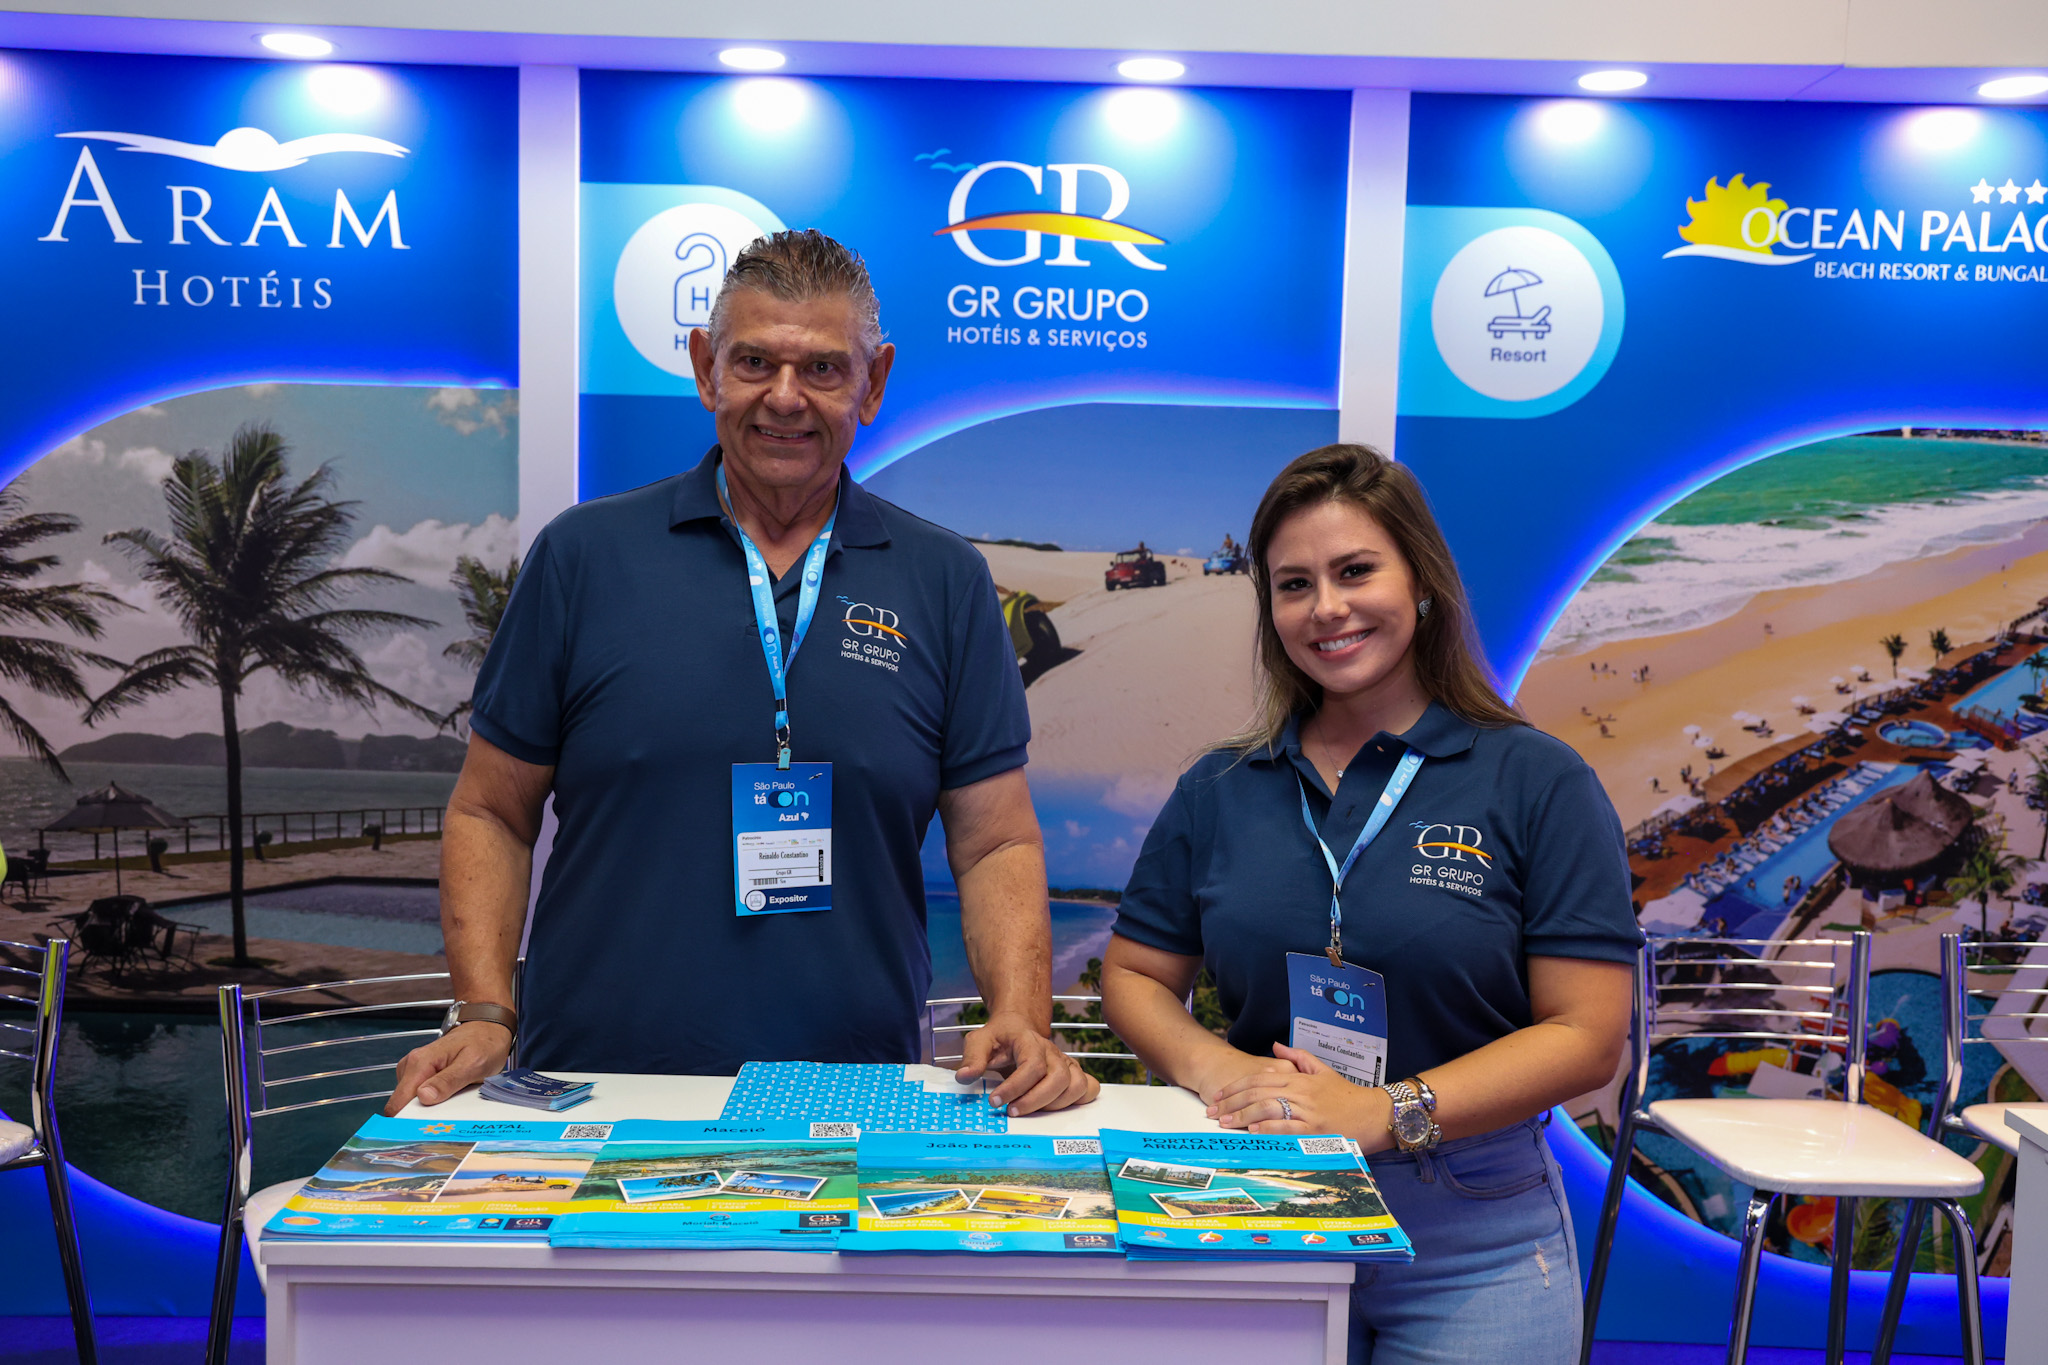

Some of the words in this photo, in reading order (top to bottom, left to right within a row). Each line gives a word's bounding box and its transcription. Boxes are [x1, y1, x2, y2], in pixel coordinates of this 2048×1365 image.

[37, 144, 411, 249] ARAM
[947, 160, 1167, 271] GR
[1741, 206, 1905, 251] OCEAN
[1814, 261, 1875, 280] BEACH
[1879, 262, 1952, 281] RESORT
[1954, 263, 1969, 282] &
[1974, 264, 2048, 283] BUNGAL
[132, 268, 333, 309] HOTÉIS
[947, 284, 1001, 318] GR
[1013, 286, 1149, 323] GRUPO
[947, 323, 1021, 345] HOTÉIS
[1027, 328, 1041, 346] &
[1047, 328, 1148, 352] SERVIÇOS
[1490, 347, 1547, 362] Resort
[845, 602, 907, 649] GR
[840, 649, 864, 662] HOTÉIS
[870, 657, 900, 673] SERVIÇOS
[841, 638, 860, 652] GR
[863, 643, 901, 663] GRUPO
[753, 781, 771, 791] São
[772, 781, 796, 791] Paulo
[753, 793, 767, 805] tá
[778, 812, 800, 822] Azul
[758, 851, 780, 860] Reinaldo
[780, 850, 809, 860] Constantino
[1417, 823, 1492, 870] GR
[1411, 863, 1432, 877] GR
[1437, 866, 1484, 886] GRUPO
[1409, 876, 1438, 887] HOTÉIS
[1438, 880, 1445, 888] &
[1445, 881, 1483, 897] SERVIÇOS
[768, 893, 809, 905] Expositor
[1309, 973, 1327, 986] São
[1327, 977, 1351, 991] Paulo
[1309, 985, 1323, 998] tá
[1334, 1009, 1355, 1023] Azul
[1317, 1039, 1336, 1052] Isadora
[1336, 1045, 1365, 1061] Constantino
[703, 1126, 766, 1134] Maceió
[1142, 1137, 1204, 1145] PORTO
[1208, 1138, 1281, 1146] SEGURO
[1143, 1143, 1220, 1151] ARRAIAL
[1224, 1144, 1299, 1152] D'AJUDA
